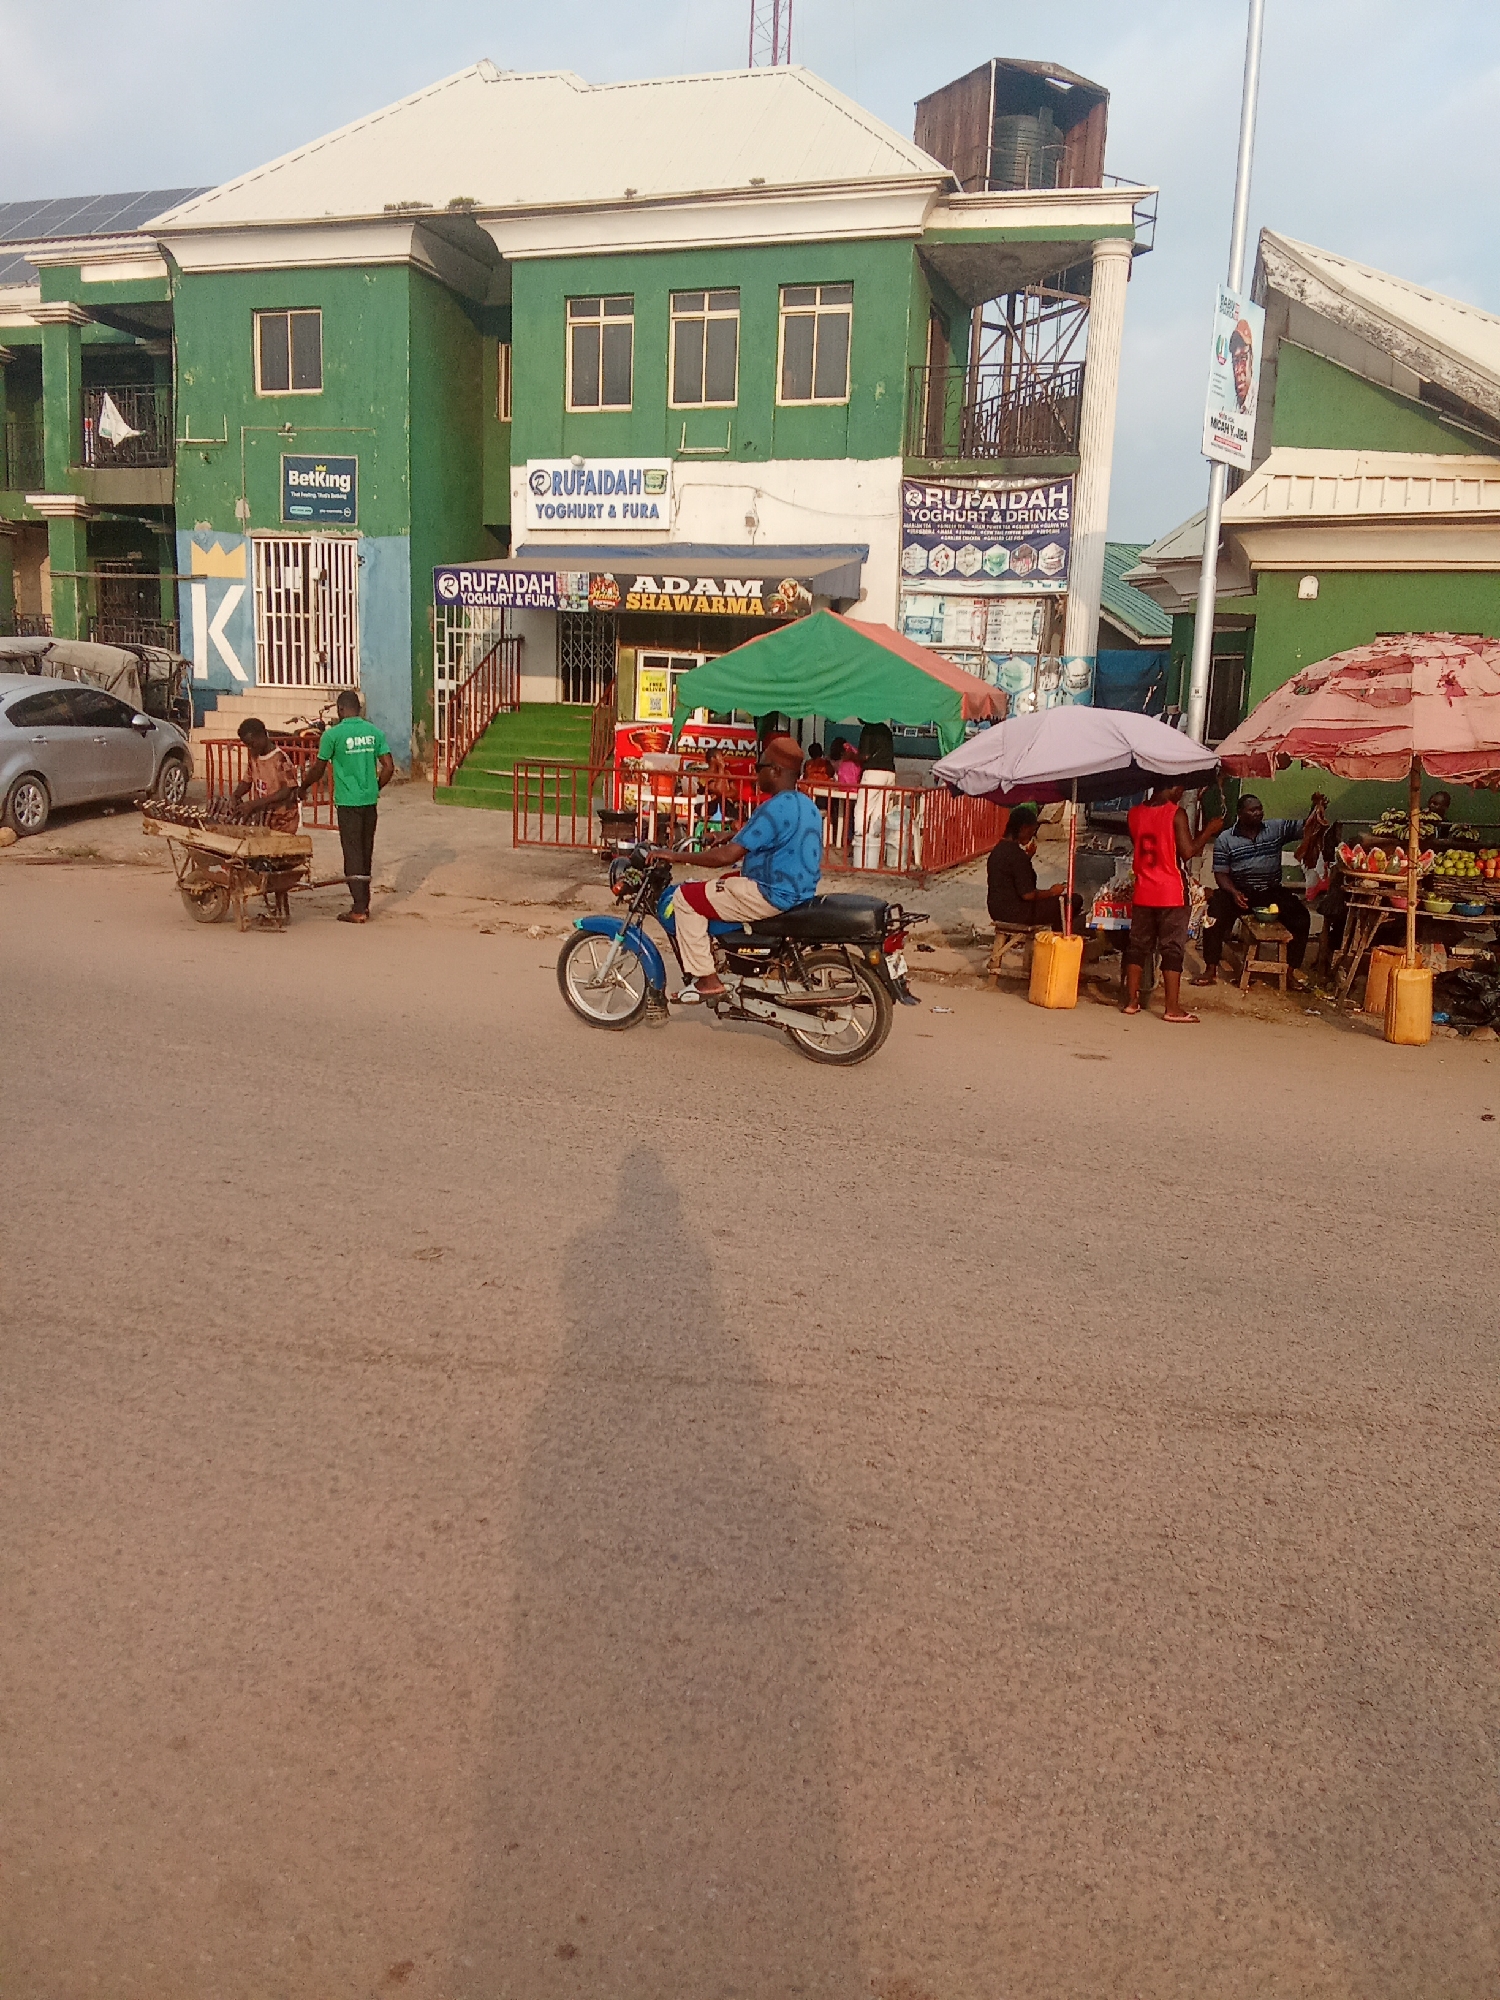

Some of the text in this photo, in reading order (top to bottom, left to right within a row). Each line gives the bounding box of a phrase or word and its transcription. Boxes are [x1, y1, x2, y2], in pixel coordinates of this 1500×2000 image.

[1210, 416, 1229, 434] MICAH
[288, 470, 351, 492] BetKing
[552, 469, 641, 496] RUFAIDAH
[925, 485, 1068, 510] RUFAIDAH
[535, 503, 660, 519] YOGHURT & FURA
[910, 507, 1069, 523] YOGHURT & DRINKS
[459, 572, 555, 594] RUFAIDAH
[629, 575, 764, 597] ADAM
[460, 593, 556, 607] YOGHURT & FURA
[626, 593, 766, 616] SHAWARMA
[191, 583, 249, 681] K
[677, 735, 762, 752] ADAM
